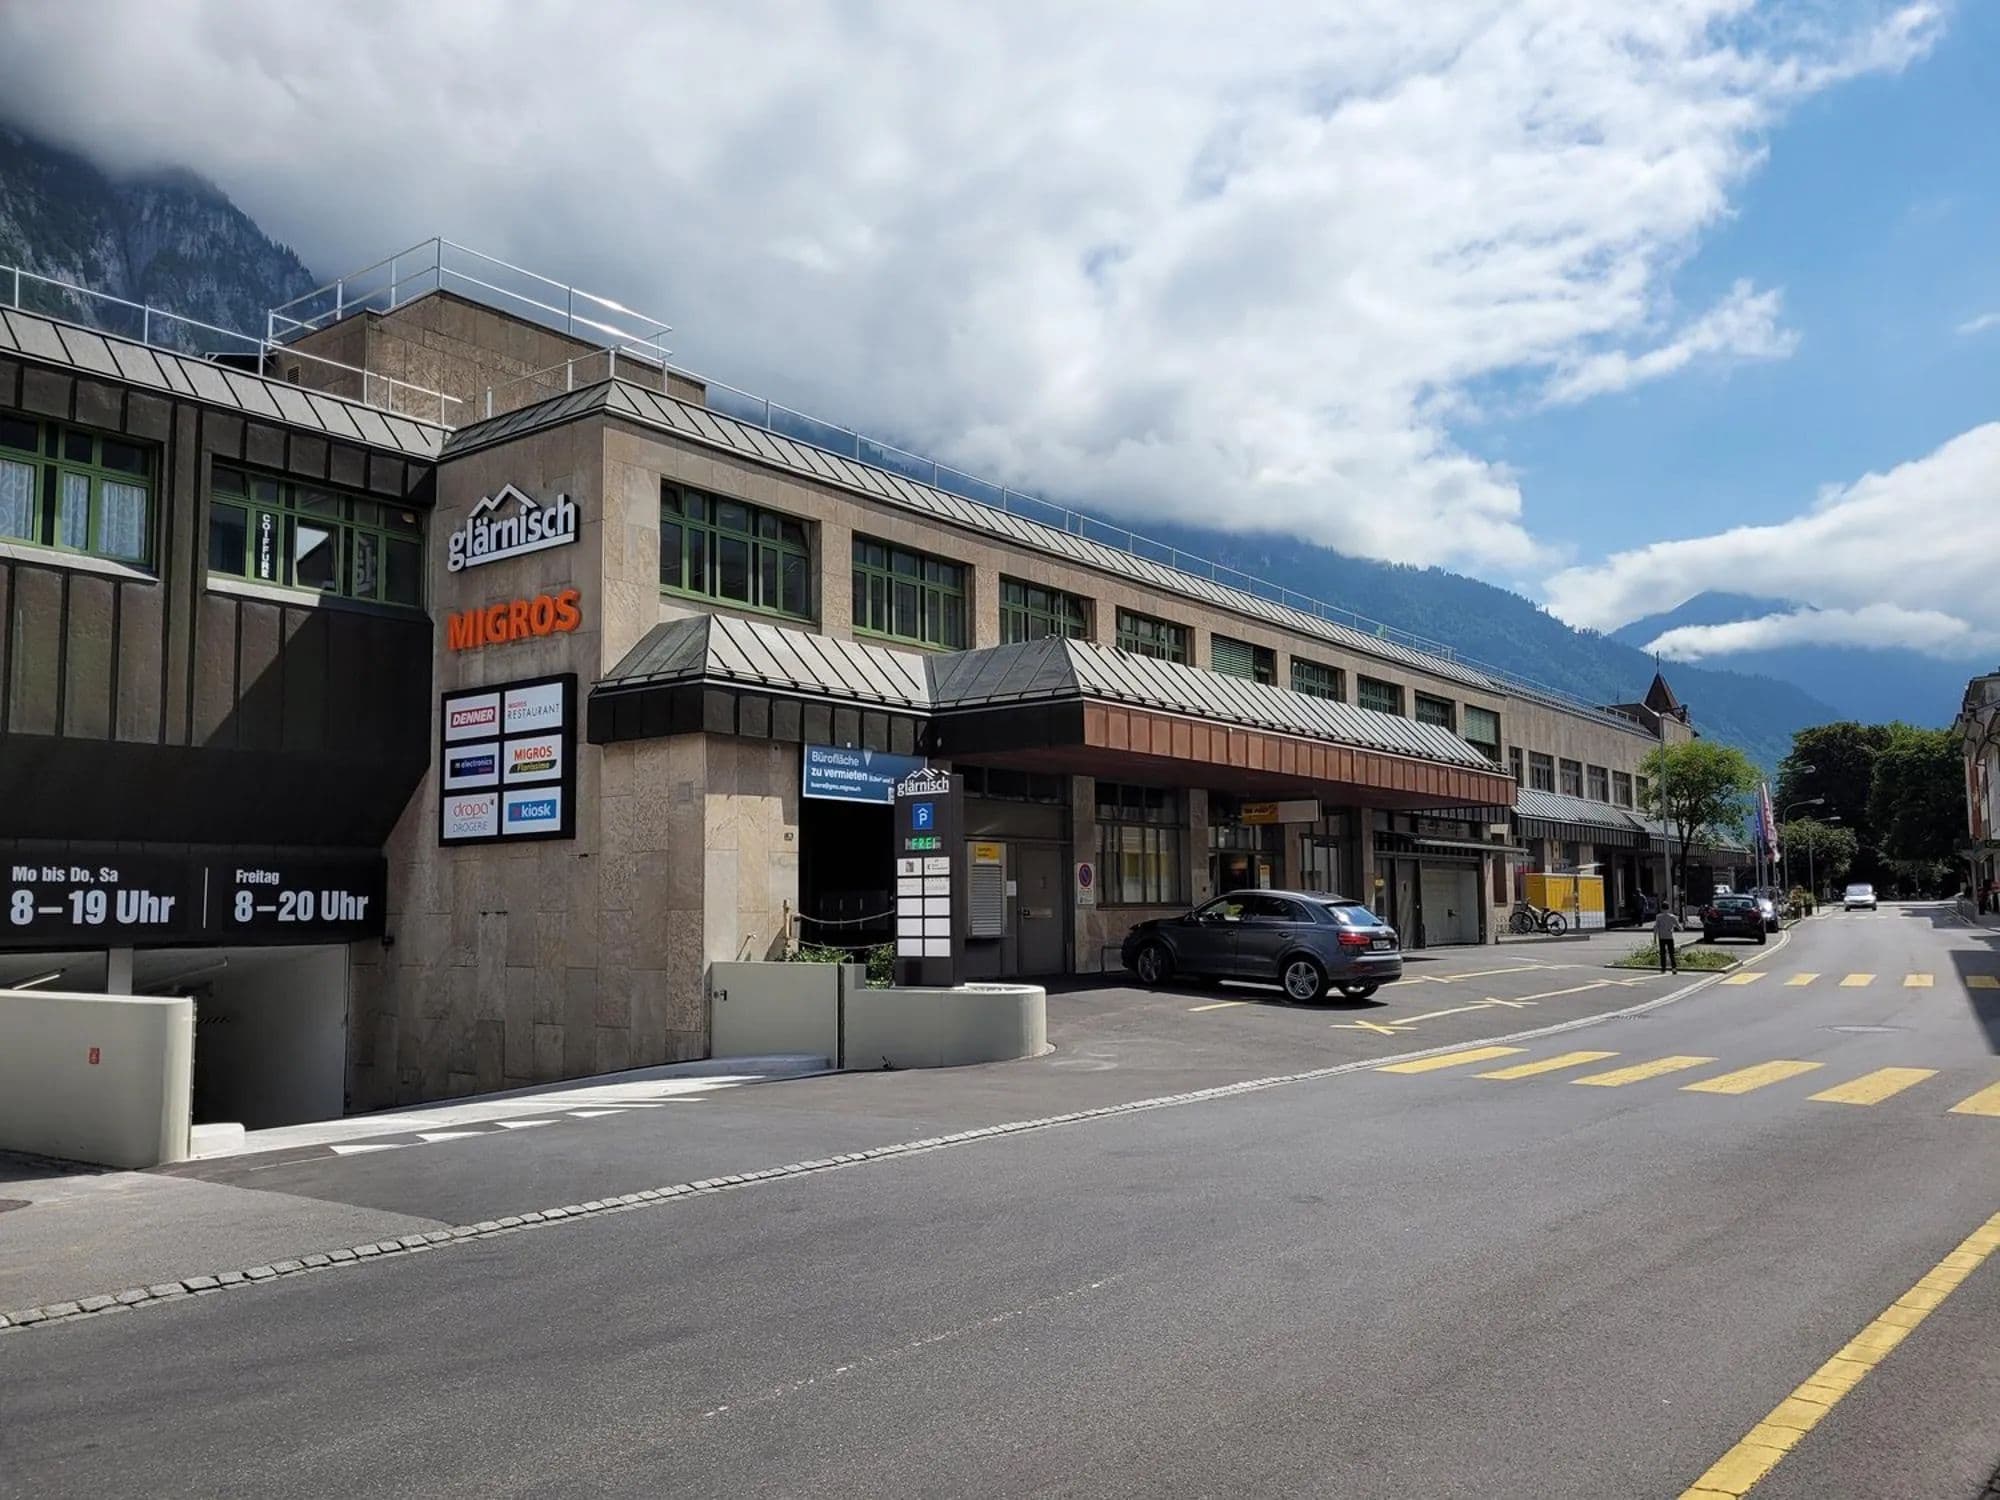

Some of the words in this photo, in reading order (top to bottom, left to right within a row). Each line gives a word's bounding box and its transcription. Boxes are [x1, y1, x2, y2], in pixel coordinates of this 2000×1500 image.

[447, 493, 577, 573] glärnisch
[261, 513, 271, 579] COIFFURE
[448, 588, 581, 651] MIGROS
[452, 709, 495, 726] DENNER
[507, 703, 560, 720] RESTAURANT
[514, 745, 553, 761] MIGROS
[811, 751, 860, 767] Bürofläche
[811, 767, 822, 777] zu
[823, 767, 868, 782] vermieten
[897, 776, 950, 797] glärnisch
[453, 801, 489, 819] dropa
[521, 803, 551, 818] kiosk
[452, 821, 488, 833] DROGERIE
[12, 866, 37, 882] Mo
[42, 866, 66, 882] bis
[70, 866, 95, 884] Do,
[99, 867, 119, 883] Sa
[235, 869, 280, 885] Freitag
[116, 889, 175, 924] Uhr
[320, 890, 369, 921] Uhr
